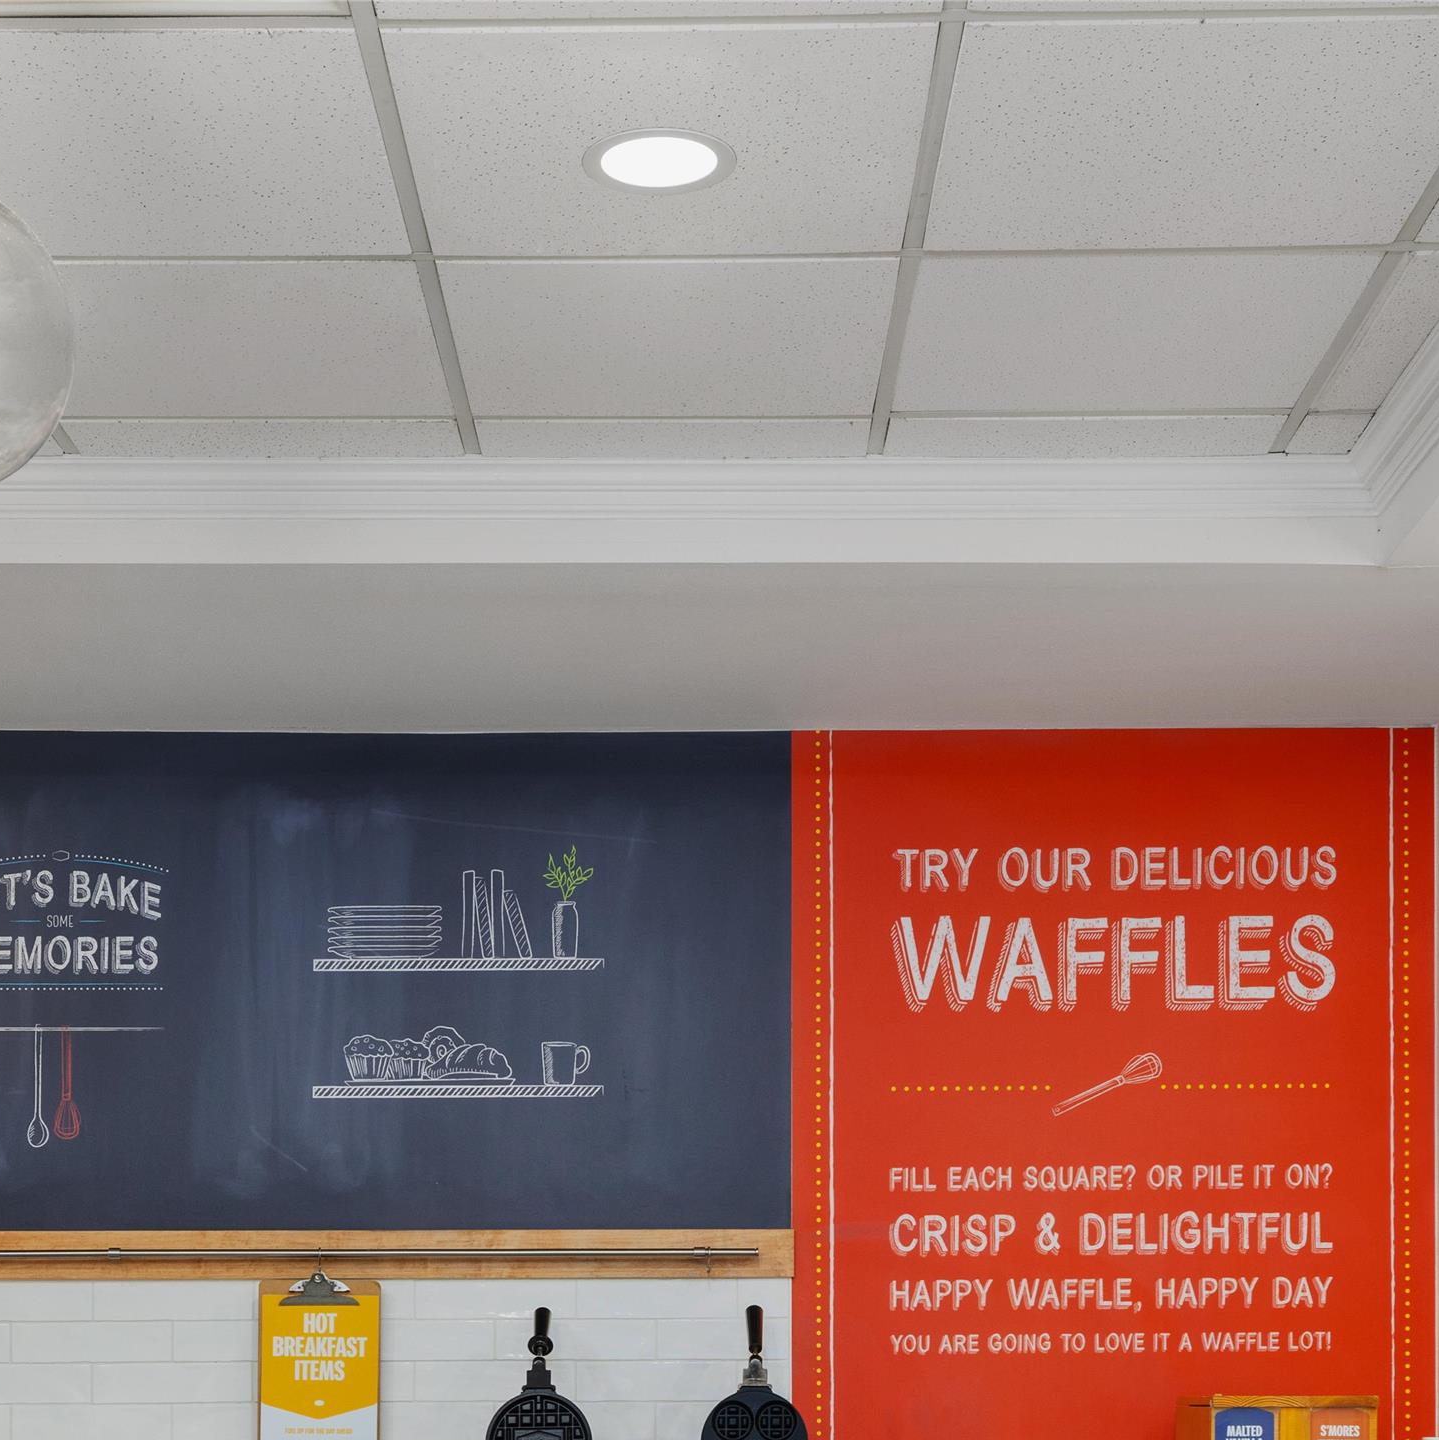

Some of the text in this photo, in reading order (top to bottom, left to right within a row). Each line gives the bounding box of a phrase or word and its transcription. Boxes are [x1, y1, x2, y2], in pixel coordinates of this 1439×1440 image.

[893, 845, 1337, 892] TRY OUR DELICIOUS
[68, 870, 161, 920] BAKE
[46, 915, 74, 928] SOME
[890, 915, 1336, 1013] WAFFLES
[889, 1163, 1334, 1191] FILL EACH SQUARE? OR PILE IT ON?
[889, 1211, 1334, 1256] CRISP & DELIGHTFUL
[889, 1276, 1334, 1314] HAPPY WAFFLE, HAPPY DAY
[303, 1313, 337, 1334] HOT
[272, 1336, 368, 1357] BREAKFAST
[890, 1331, 1332, 1354] YOU ARE GOING TO LOVE IT A WAFFLE LOT!
[294, 1360, 345, 1381] ITEMS
[1226, 1425, 1263, 1437] MALTED
[1320, 1424, 1360, 1437] S'MORES
